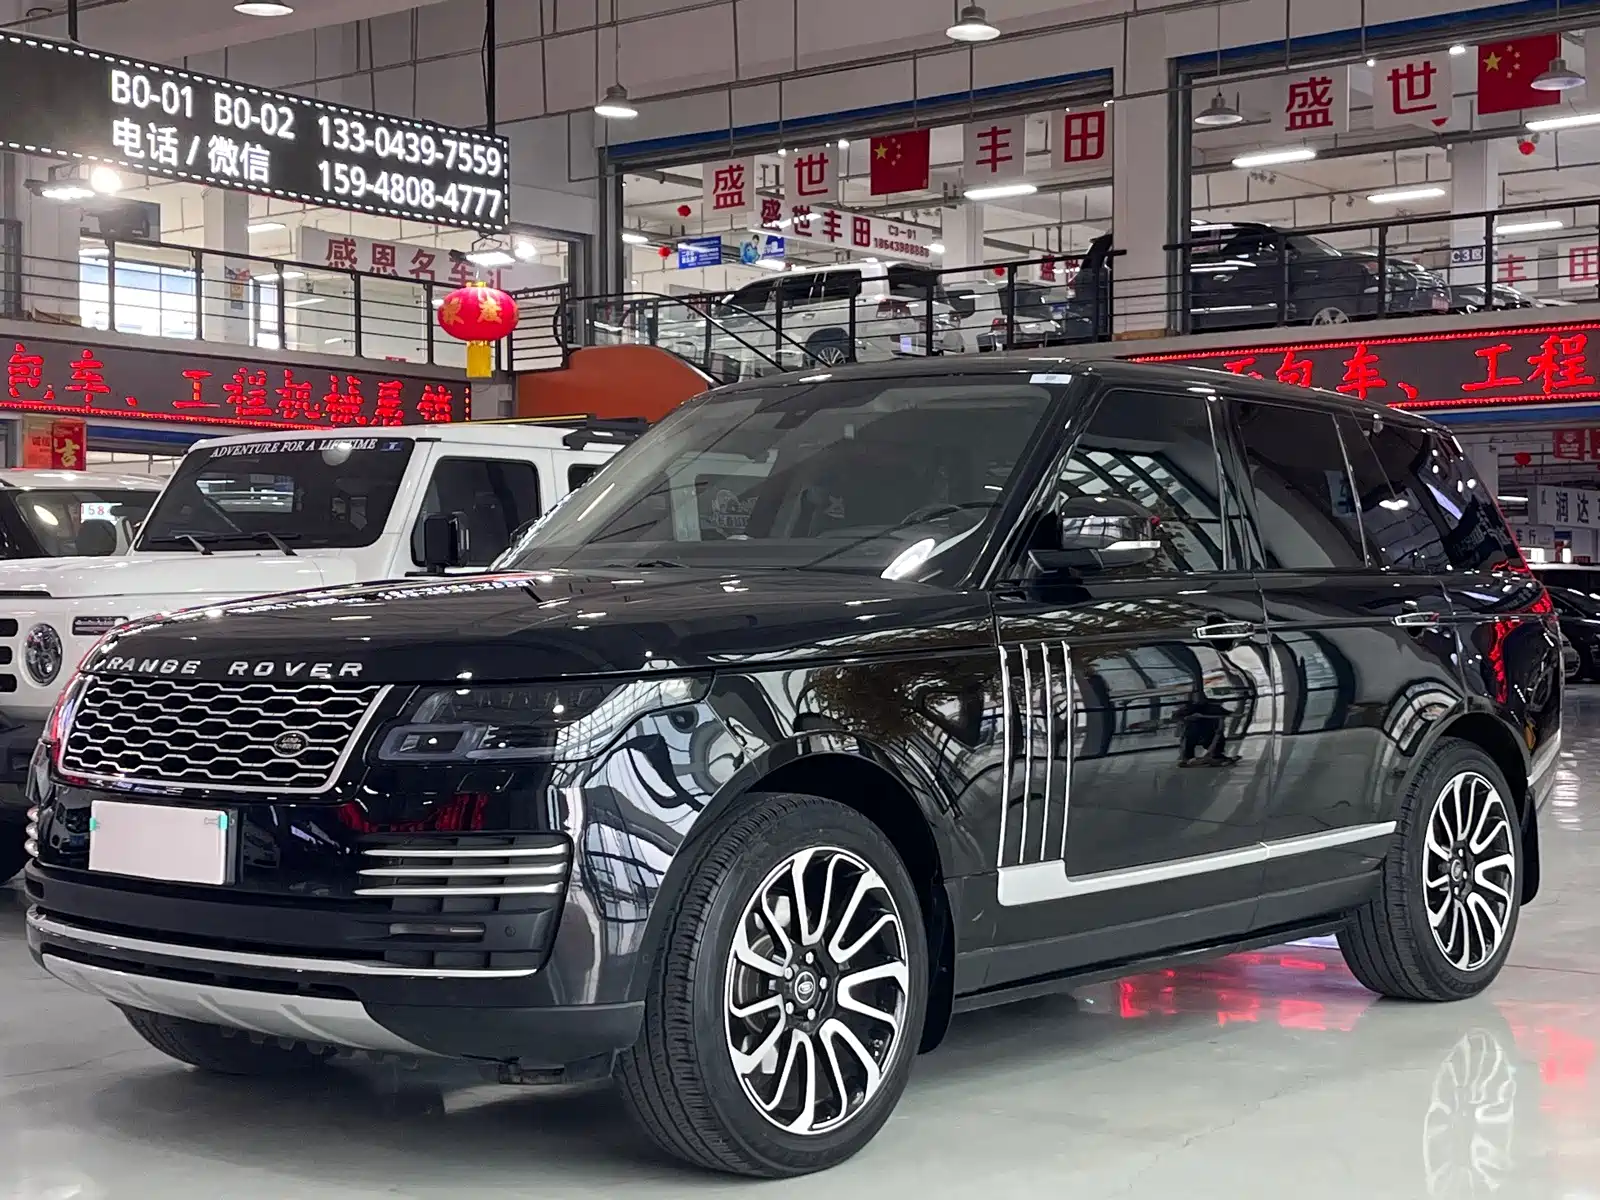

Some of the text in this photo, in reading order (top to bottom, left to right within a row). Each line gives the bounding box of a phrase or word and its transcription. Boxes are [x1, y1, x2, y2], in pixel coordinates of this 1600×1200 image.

[1285, 77, 1333, 131] 盛
[1387, 61, 1436, 114] 世
[111, 69, 502, 177] B0-01 B0-02 133-0439-7559
[1064, 111, 1106, 162] 田
[976, 126, 1012, 173] 丰
[317, 161, 502, 219] 159-4808-4777
[713, 165, 745, 210] 盛
[794, 152, 828, 197] 世
[760, 199, 871, 247] 盛世丰田
[209, 442, 279, 458] ADVENTURE
[280, 441, 306, 453] FOR
[306, 440, 321, 451] A
[106, 656, 364, 679] RANGE ROVER
